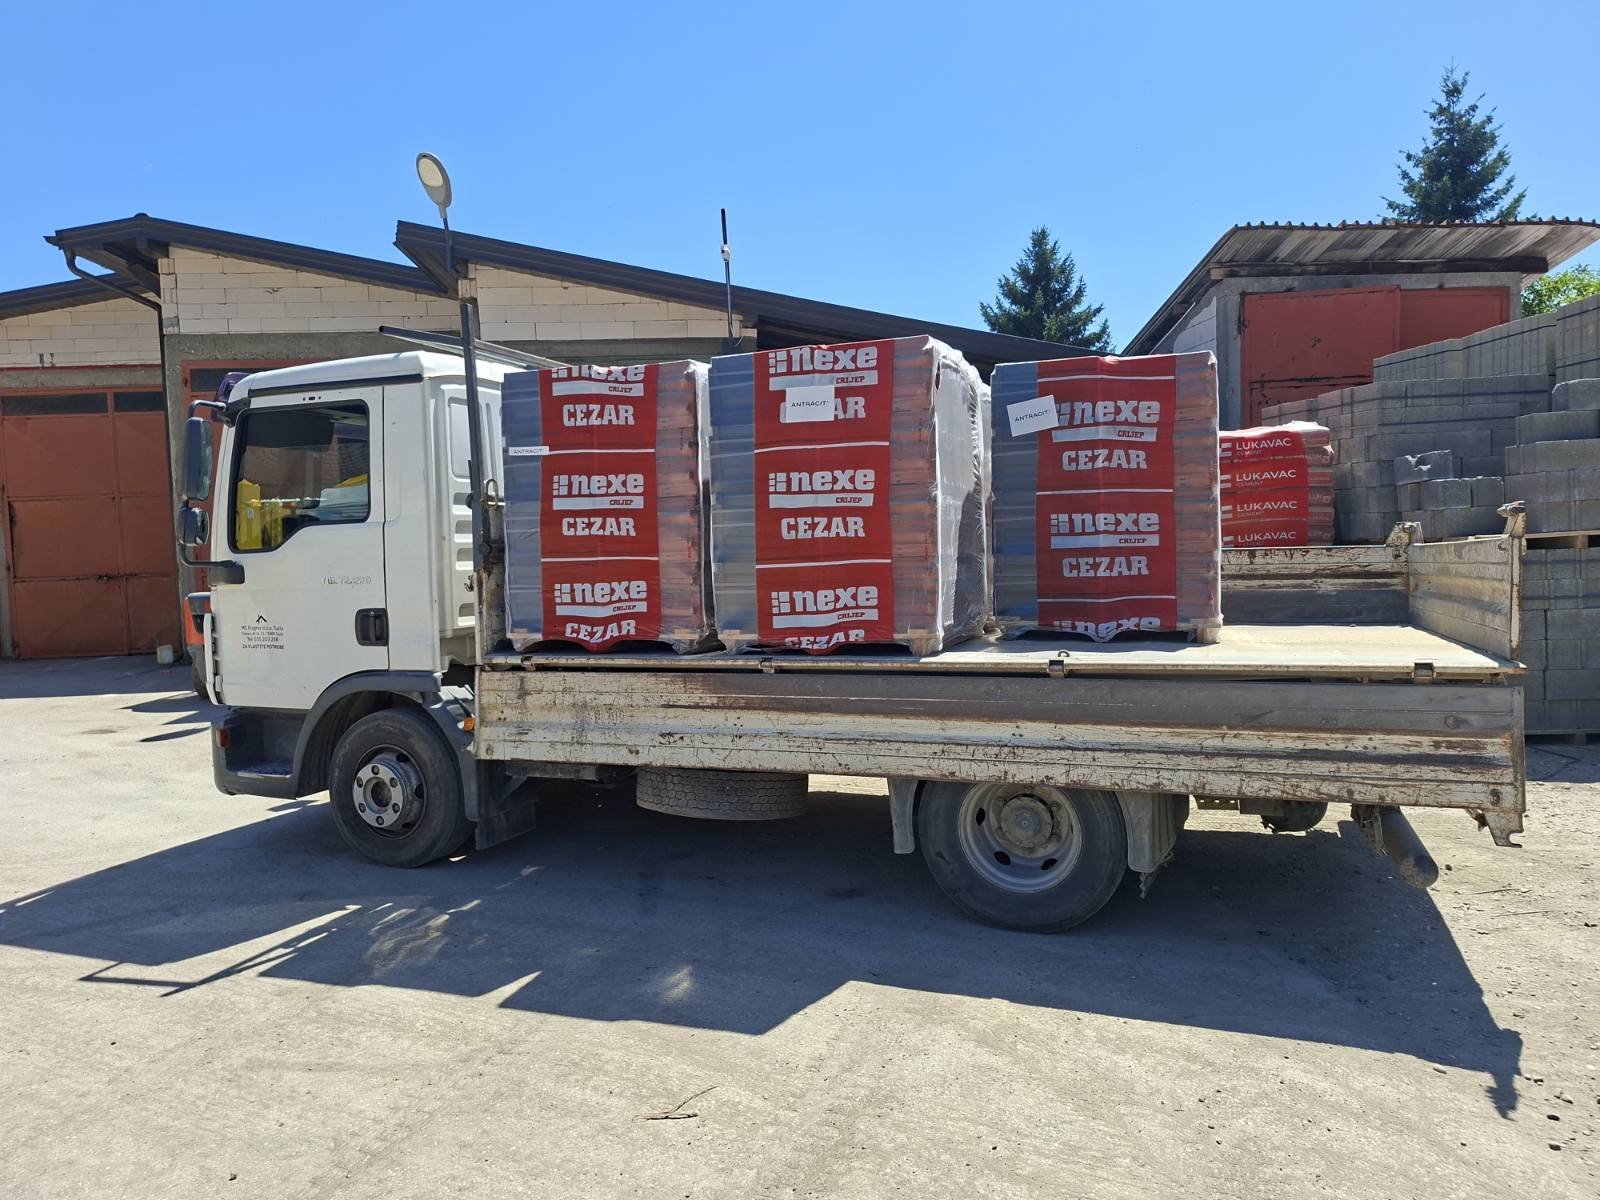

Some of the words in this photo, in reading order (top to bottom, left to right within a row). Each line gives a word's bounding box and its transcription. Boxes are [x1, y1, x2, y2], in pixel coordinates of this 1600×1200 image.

[790, 346, 878, 372] nexe
[836, 376, 865, 384] CRIJEP
[562, 404, 636, 427] CEZAR
[1073, 400, 1160, 425] nexe
[1117, 430, 1145, 439] CRIJEP
[1236, 438, 1292, 450] LUKAVAC
[1062, 449, 1148, 471] CEZAR
[570, 473, 644, 494] nexe
[790, 468, 876, 492] nexe
[1236, 469, 1297, 482] LUKAVAC
[835, 496, 863, 504] CRIJEP
[1236, 500, 1298, 512] LUKAVAC
[562, 517, 636, 536] CEZAR
[781, 516, 866, 540] CEZAR
[1072, 512, 1160, 533] nexe
[1238, 532, 1297, 542] LUKAVAC
[1062, 556, 1149, 578] CEZAR
[573, 580, 648, 604] nexe
[792, 585, 878, 612] nexe
[612, 604, 637, 612] CRIJEP
[837, 611, 866, 620] CRIJEP
[565, 618, 636, 643] CEZAR
